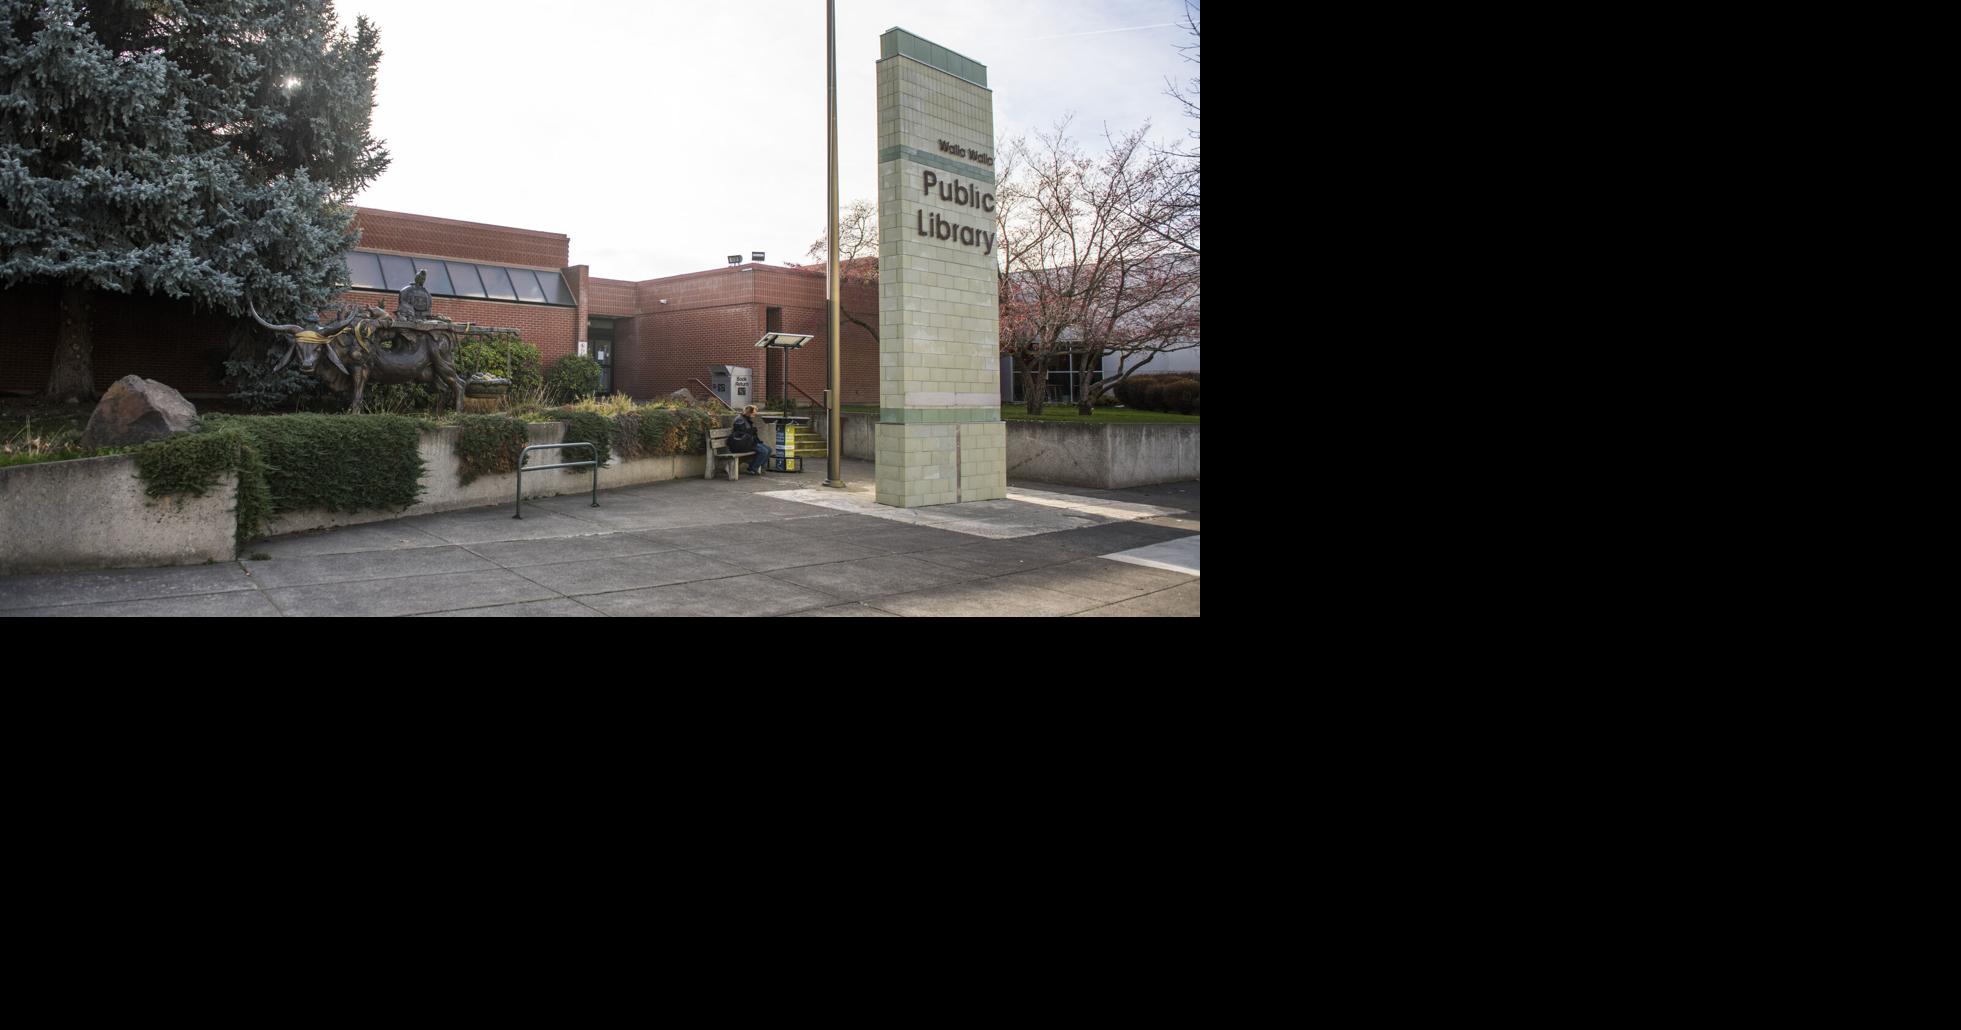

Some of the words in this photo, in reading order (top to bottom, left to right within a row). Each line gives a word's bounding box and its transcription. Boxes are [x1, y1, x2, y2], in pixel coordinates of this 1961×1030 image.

[938, 139, 965, 158] Walla
[968, 148, 993, 166] Walla
[923, 170, 995, 213] Public
[917, 209, 995, 256] Library
